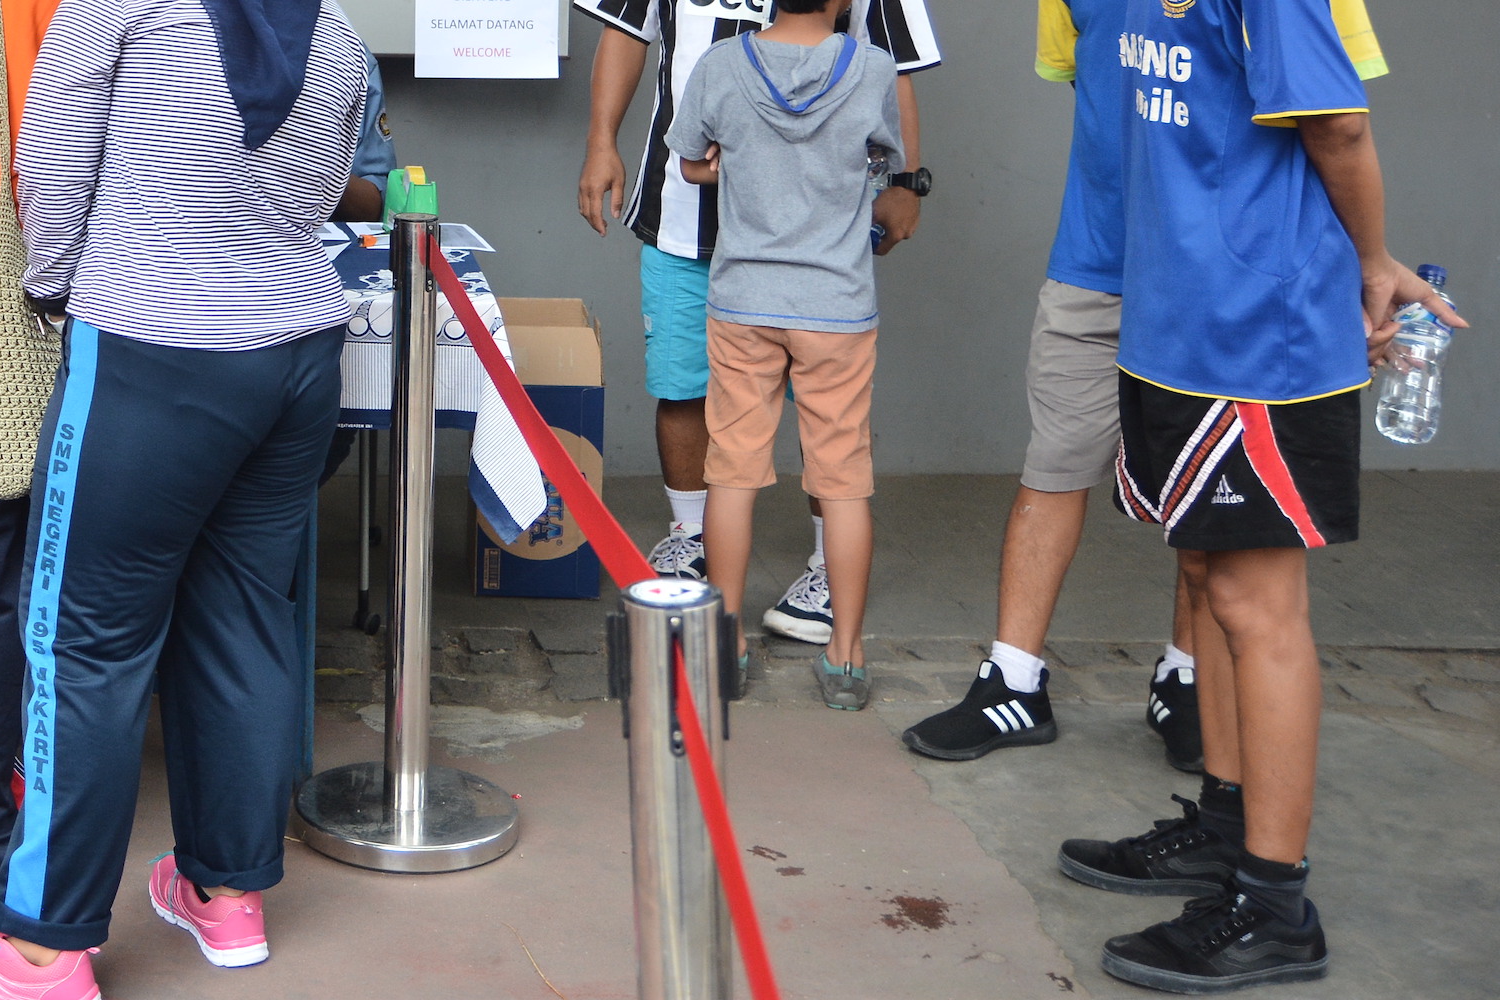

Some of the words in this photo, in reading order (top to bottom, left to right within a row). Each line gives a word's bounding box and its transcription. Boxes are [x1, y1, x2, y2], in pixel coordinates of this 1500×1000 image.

[431, 19, 483, 29] SELAMAT
[486, 19, 534, 30] DATANG
[453, 47, 512, 58] WELCOME
[52, 423, 75, 475] SMP
[41, 488, 66, 591] NEGERI
[32, 606, 49, 656] 195
[33, 667, 50, 795] JAKARTA
